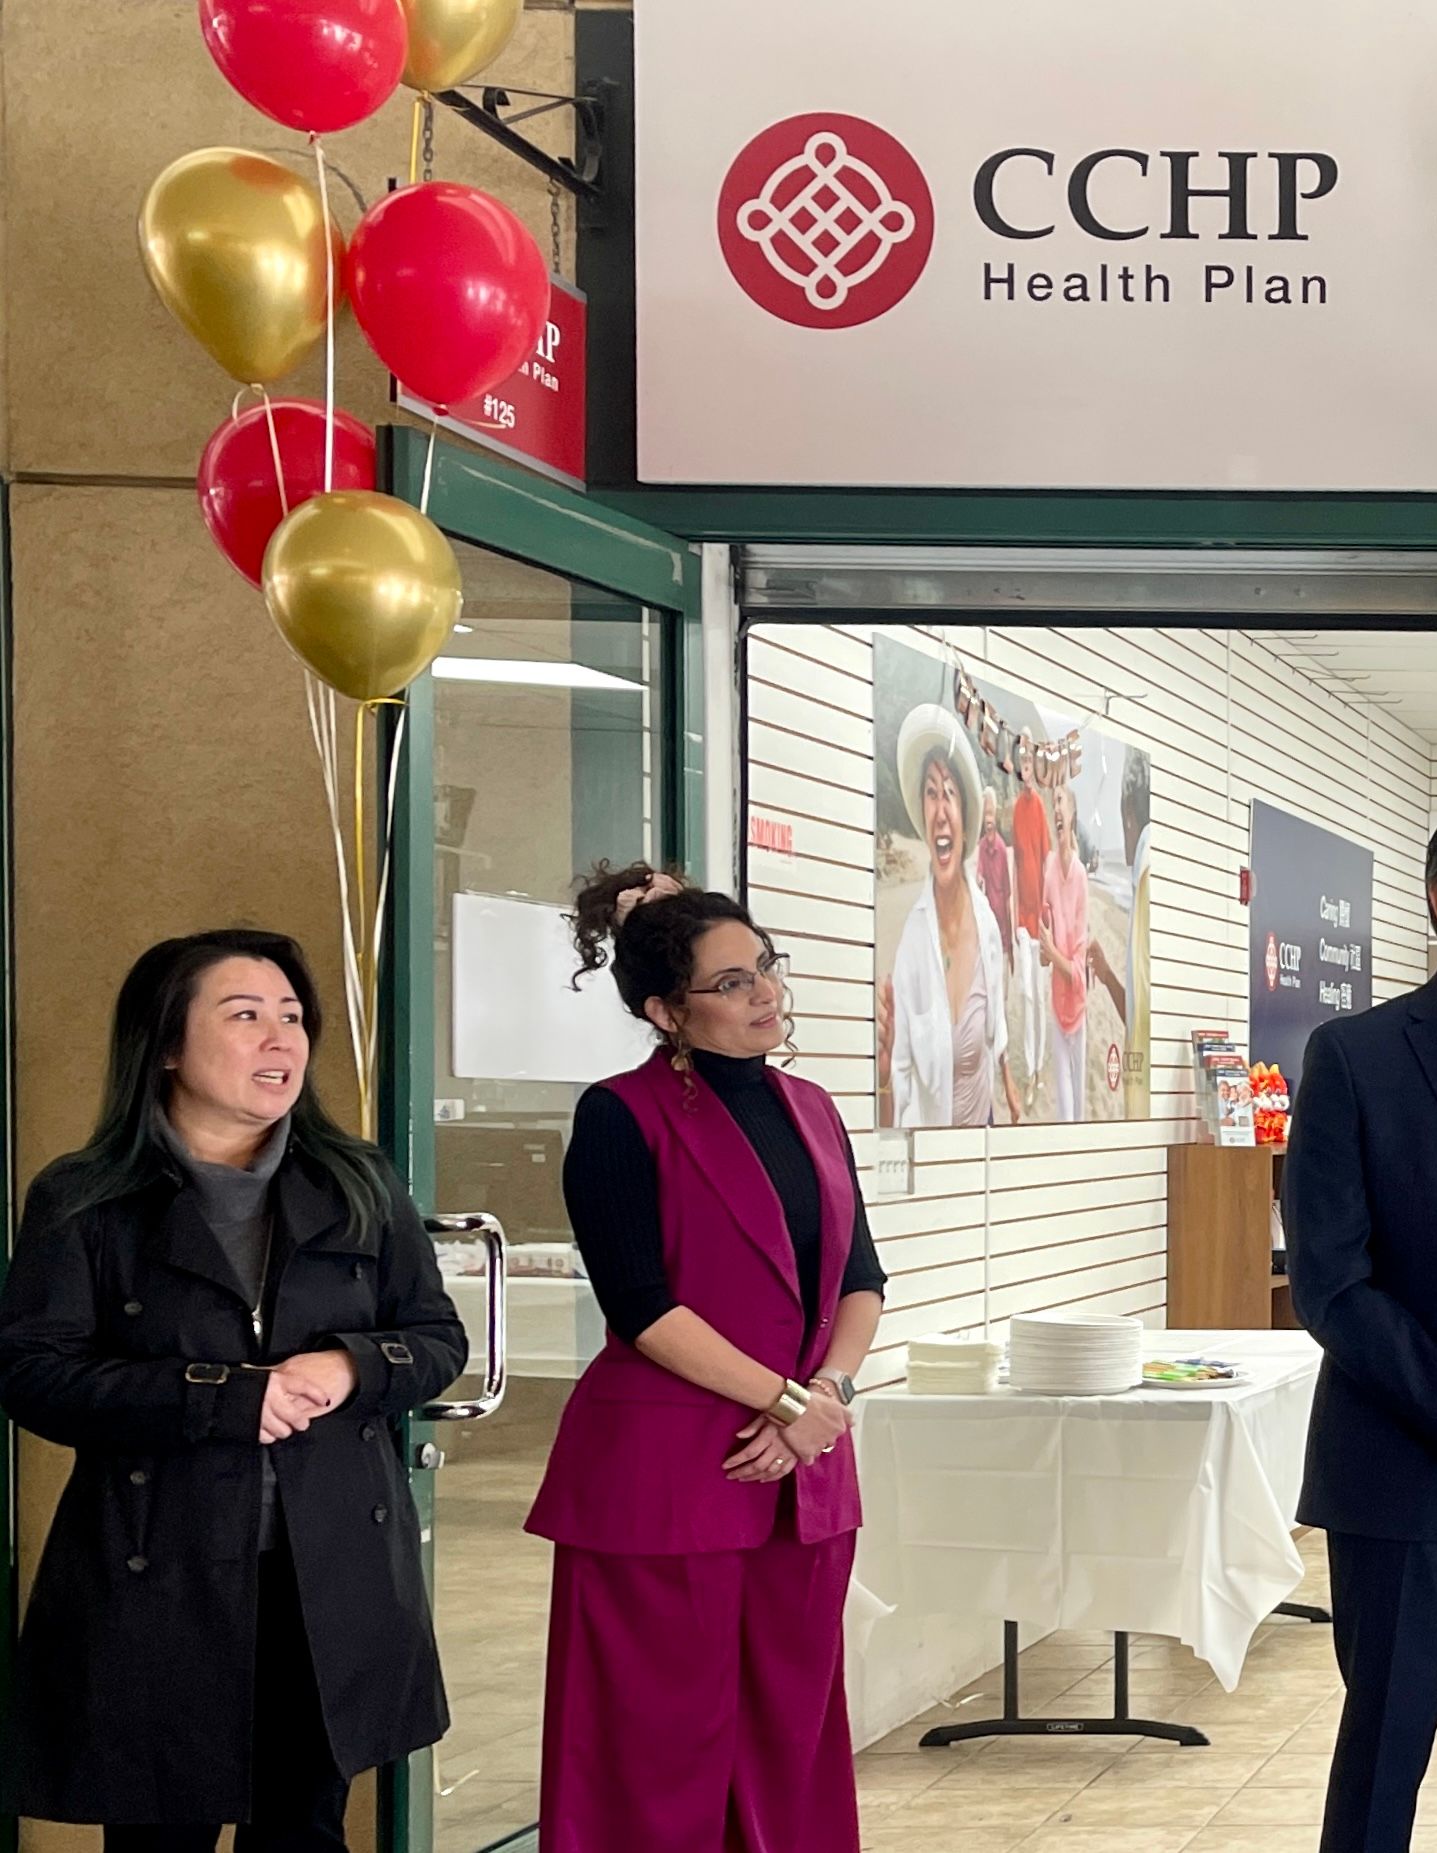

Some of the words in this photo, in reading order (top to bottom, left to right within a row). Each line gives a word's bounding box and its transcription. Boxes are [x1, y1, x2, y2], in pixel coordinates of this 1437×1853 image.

[973, 148, 1339, 241] CCHP
[982, 263, 1172, 304] Health
[1205, 264, 1329, 305] Plan
[533, 362, 559, 391] Plan
[483, 393, 516, 428] #125
[750, 815, 793, 855] SMOKING
[1279, 942, 1301, 971] CCHP
